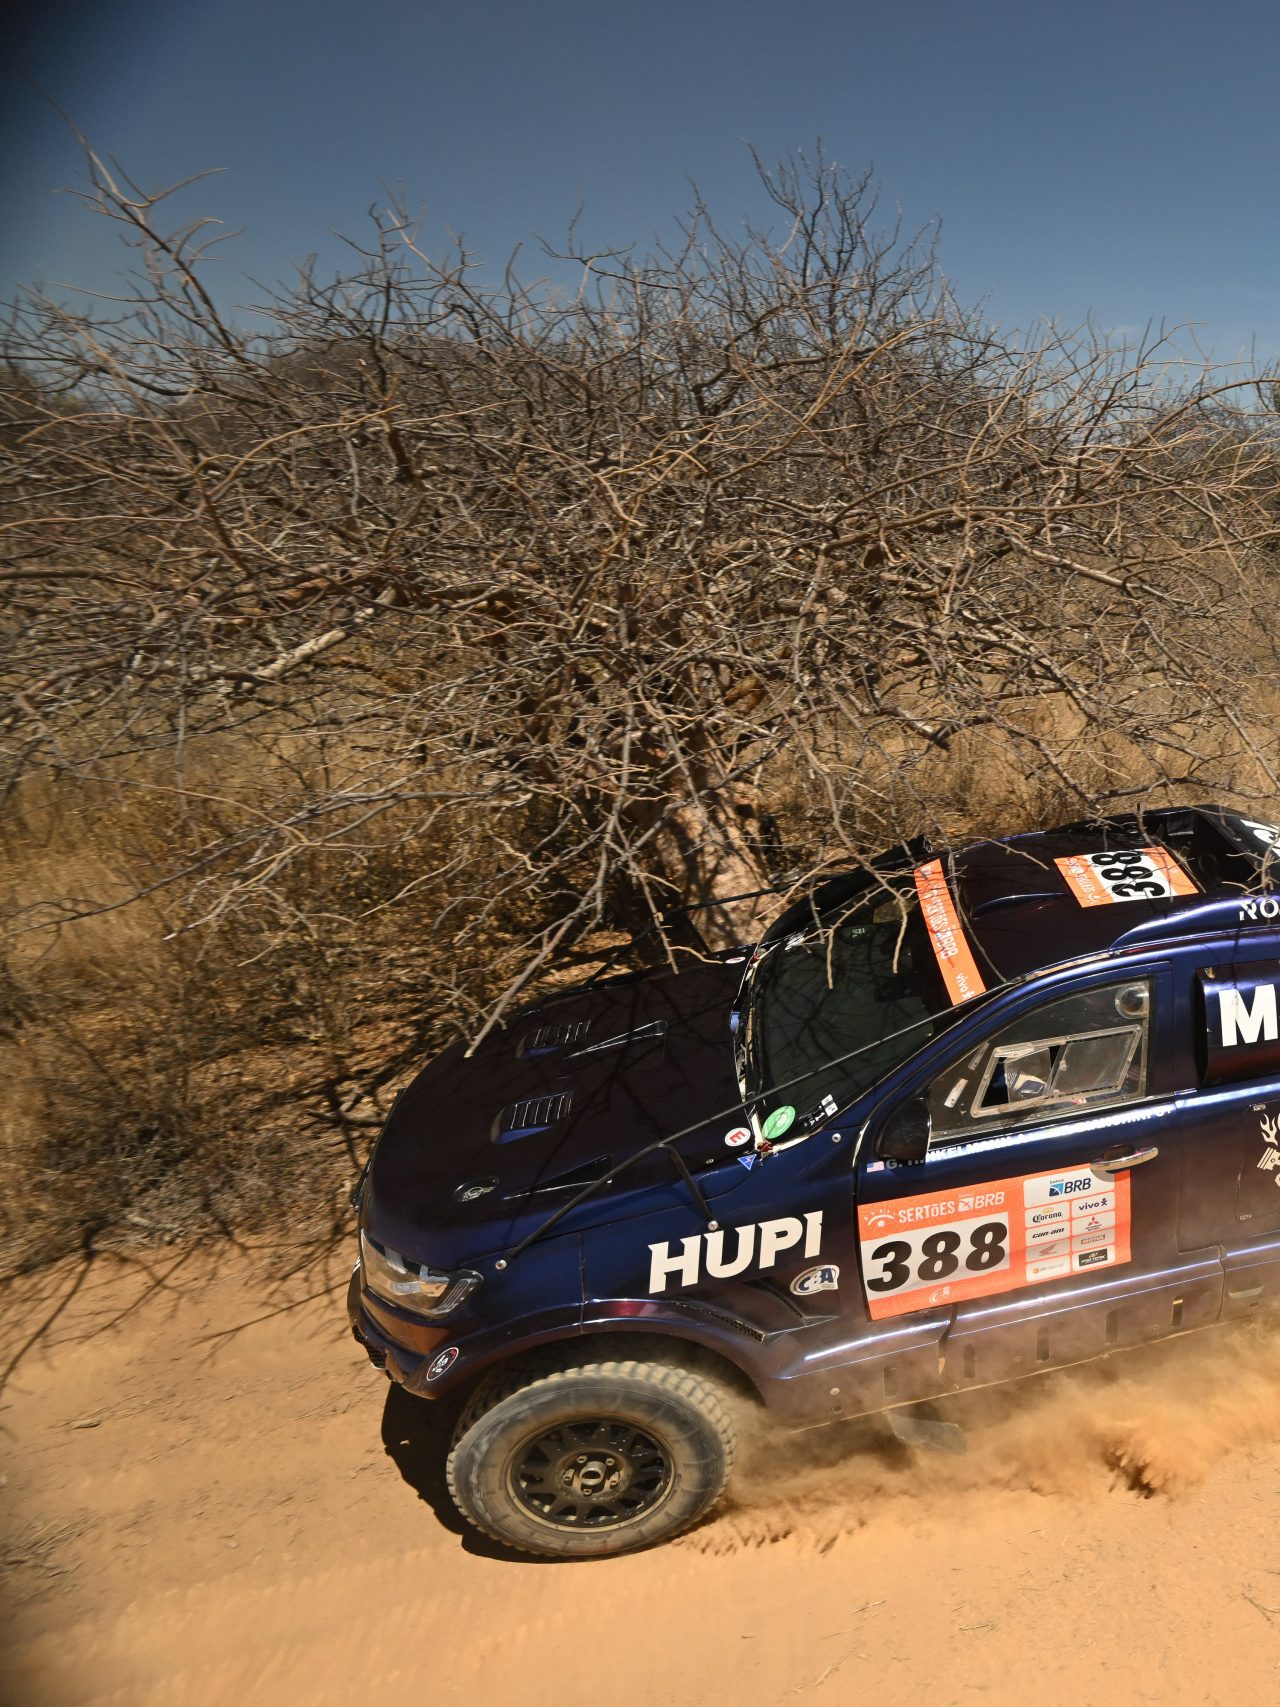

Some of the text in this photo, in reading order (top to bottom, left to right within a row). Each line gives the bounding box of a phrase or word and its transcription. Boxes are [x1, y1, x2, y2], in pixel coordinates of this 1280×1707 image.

[1091, 851, 1166, 897] 388
[956, 972, 970, 993] vivo
[1064, 1178, 1092, 1194] BRB
[975, 1191, 1005, 1209] BRB
[1078, 1202, 1099, 1211] vivo
[1032, 1211, 1062, 1223] Corona
[647, 1210, 824, 1294] HUPI
[867, 1222, 1008, 1292] 388
